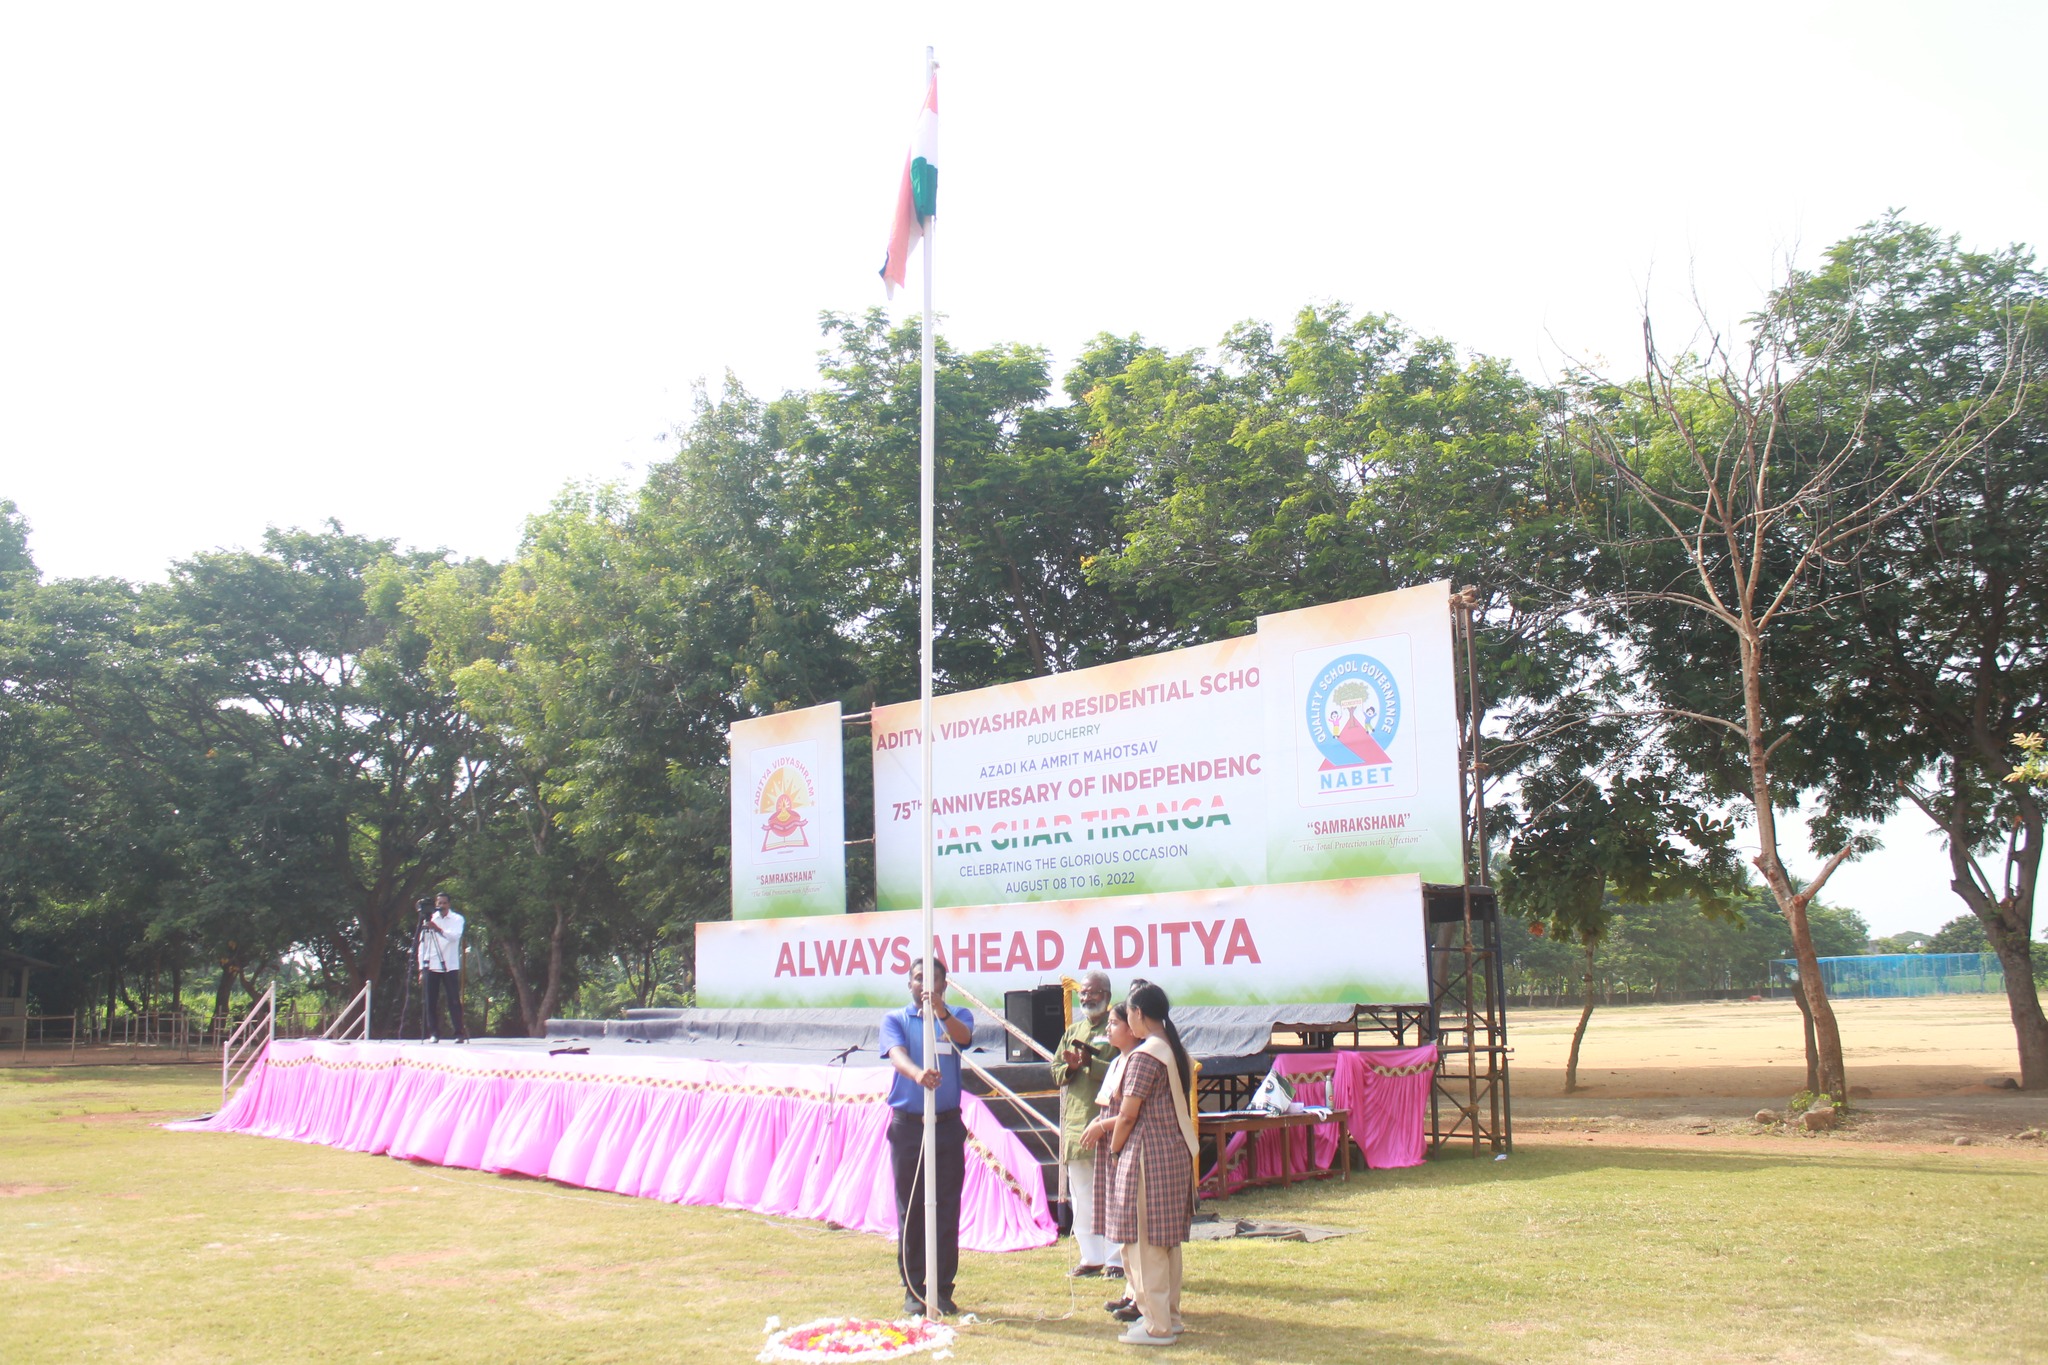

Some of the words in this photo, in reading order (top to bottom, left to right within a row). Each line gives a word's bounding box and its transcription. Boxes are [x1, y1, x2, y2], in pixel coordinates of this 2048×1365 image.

[940, 704, 1056, 740] VIDYASHRAM
[1062, 680, 1194, 720] RESIDENTIAL
[1200, 667, 1260, 696] SCHO
[1311, 691, 1326, 743] QUALITY
[1320, 660, 1358, 691] SCHOOL
[1361, 661, 1396, 734] GOVERNANCE
[1027, 724, 1101, 746] PUDUCHERRY
[980, 763, 1016, 779] AZADI
[1020, 759, 1037, 772] KA
[1041, 752, 1080, 770] AMRIT
[1083, 740, 1158, 763] MAHOTSAV
[1320, 767, 1392, 790] NABET
[932, 781, 1062, 816] ANNIVERSARY
[1068, 777, 1096, 798] OF
[1102, 753, 1262, 794] INDEPENDENC
[991, 814, 1073, 851] GHAR
[1081, 795, 1231, 841] TIRANGA
[959, 860, 1032, 877] CELEBRATING
[1035, 857, 1057, 870] THE
[1060, 851, 1119, 867] GLORIOUS
[1123, 844, 1188, 862] OCCASION
[1317, 842, 1333, 851] Total
[1335, 839, 1368, 850] Protection
[1370, 837, 1385, 847] with
[1005, 878, 1049, 894] AUGUST
[1053, 877, 1068, 890] 08
[1070, 875, 1086, 888] TO
[1089, 874, 1104, 888] 16,
[1107, 872, 1135, 886] 2022
[774, 936, 911, 978] ALWAYS
[1078, 918, 1262, 970] ADITYA
